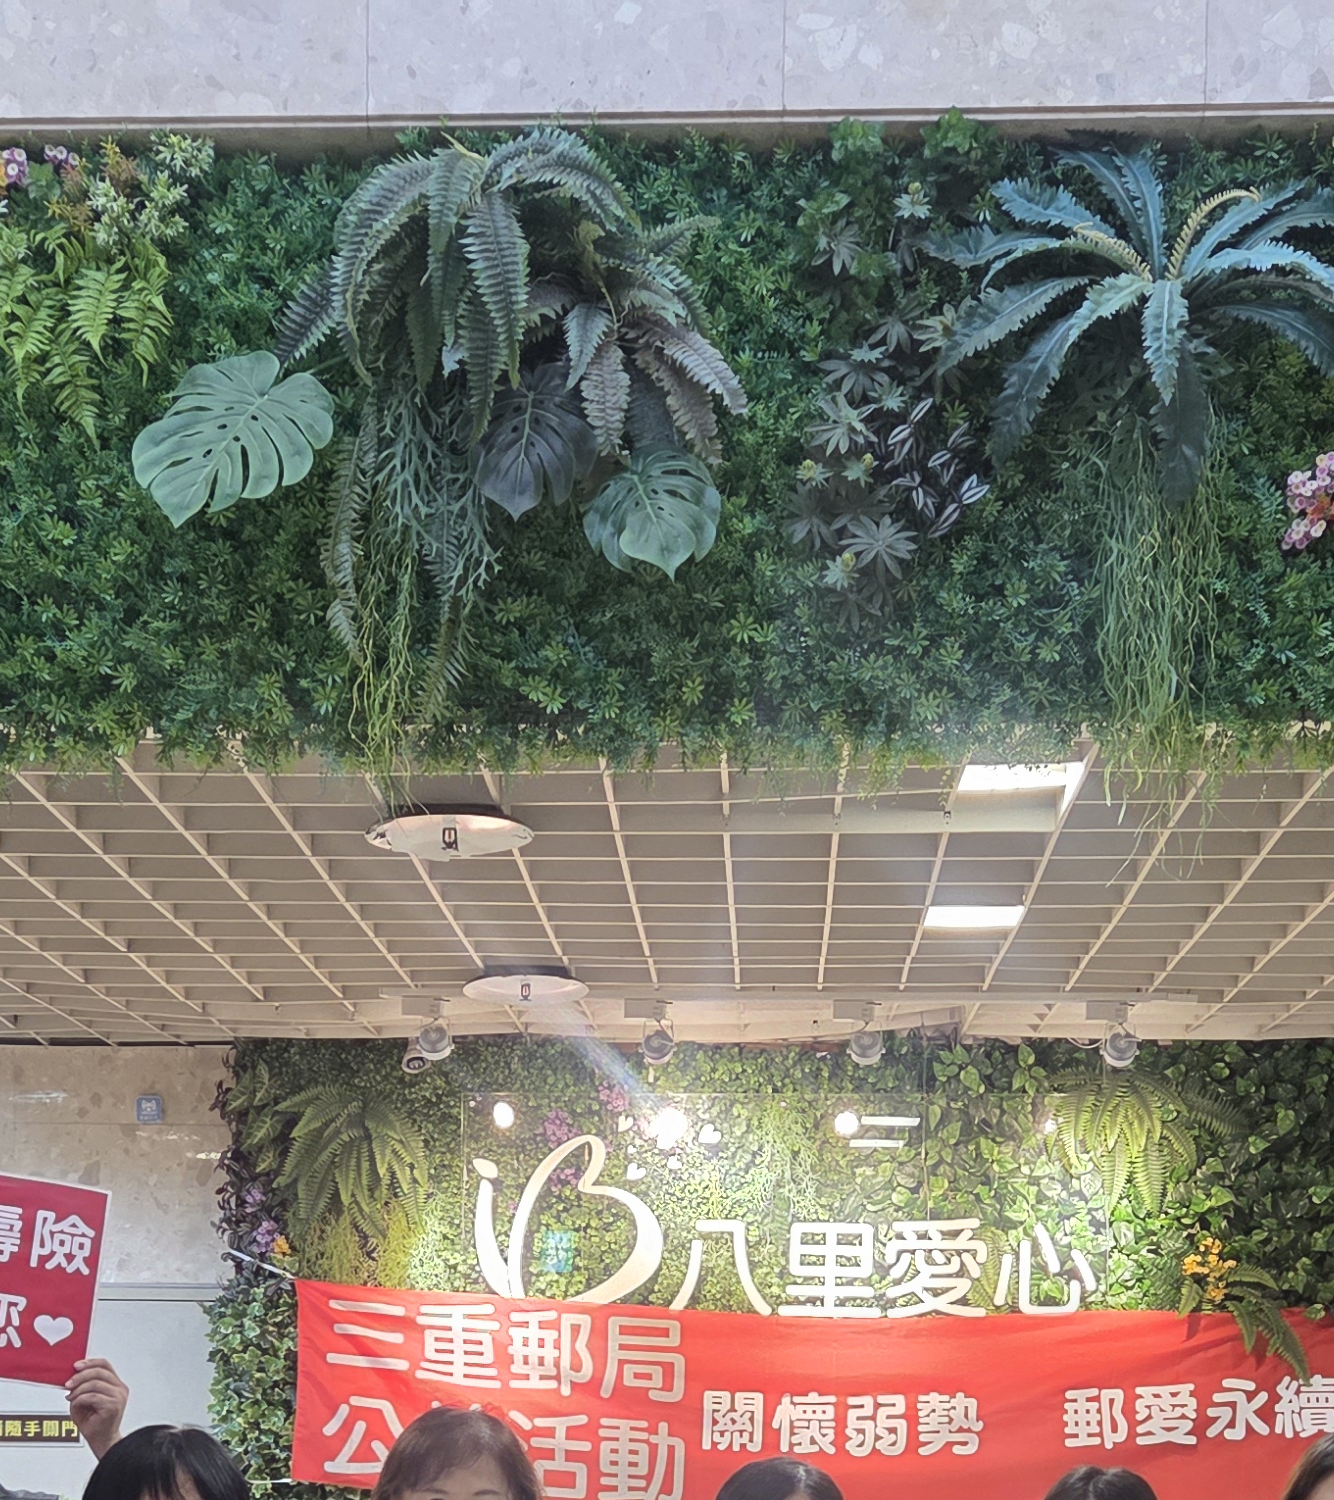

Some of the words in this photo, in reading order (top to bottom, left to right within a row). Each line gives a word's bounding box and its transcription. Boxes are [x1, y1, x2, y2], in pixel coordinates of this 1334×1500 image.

[669, 1219, 1096, 1319] 八里愛心
[326, 1299, 686, 1402] 三重郵局
[701, 1390, 984, 1457] 關懷弱勢
